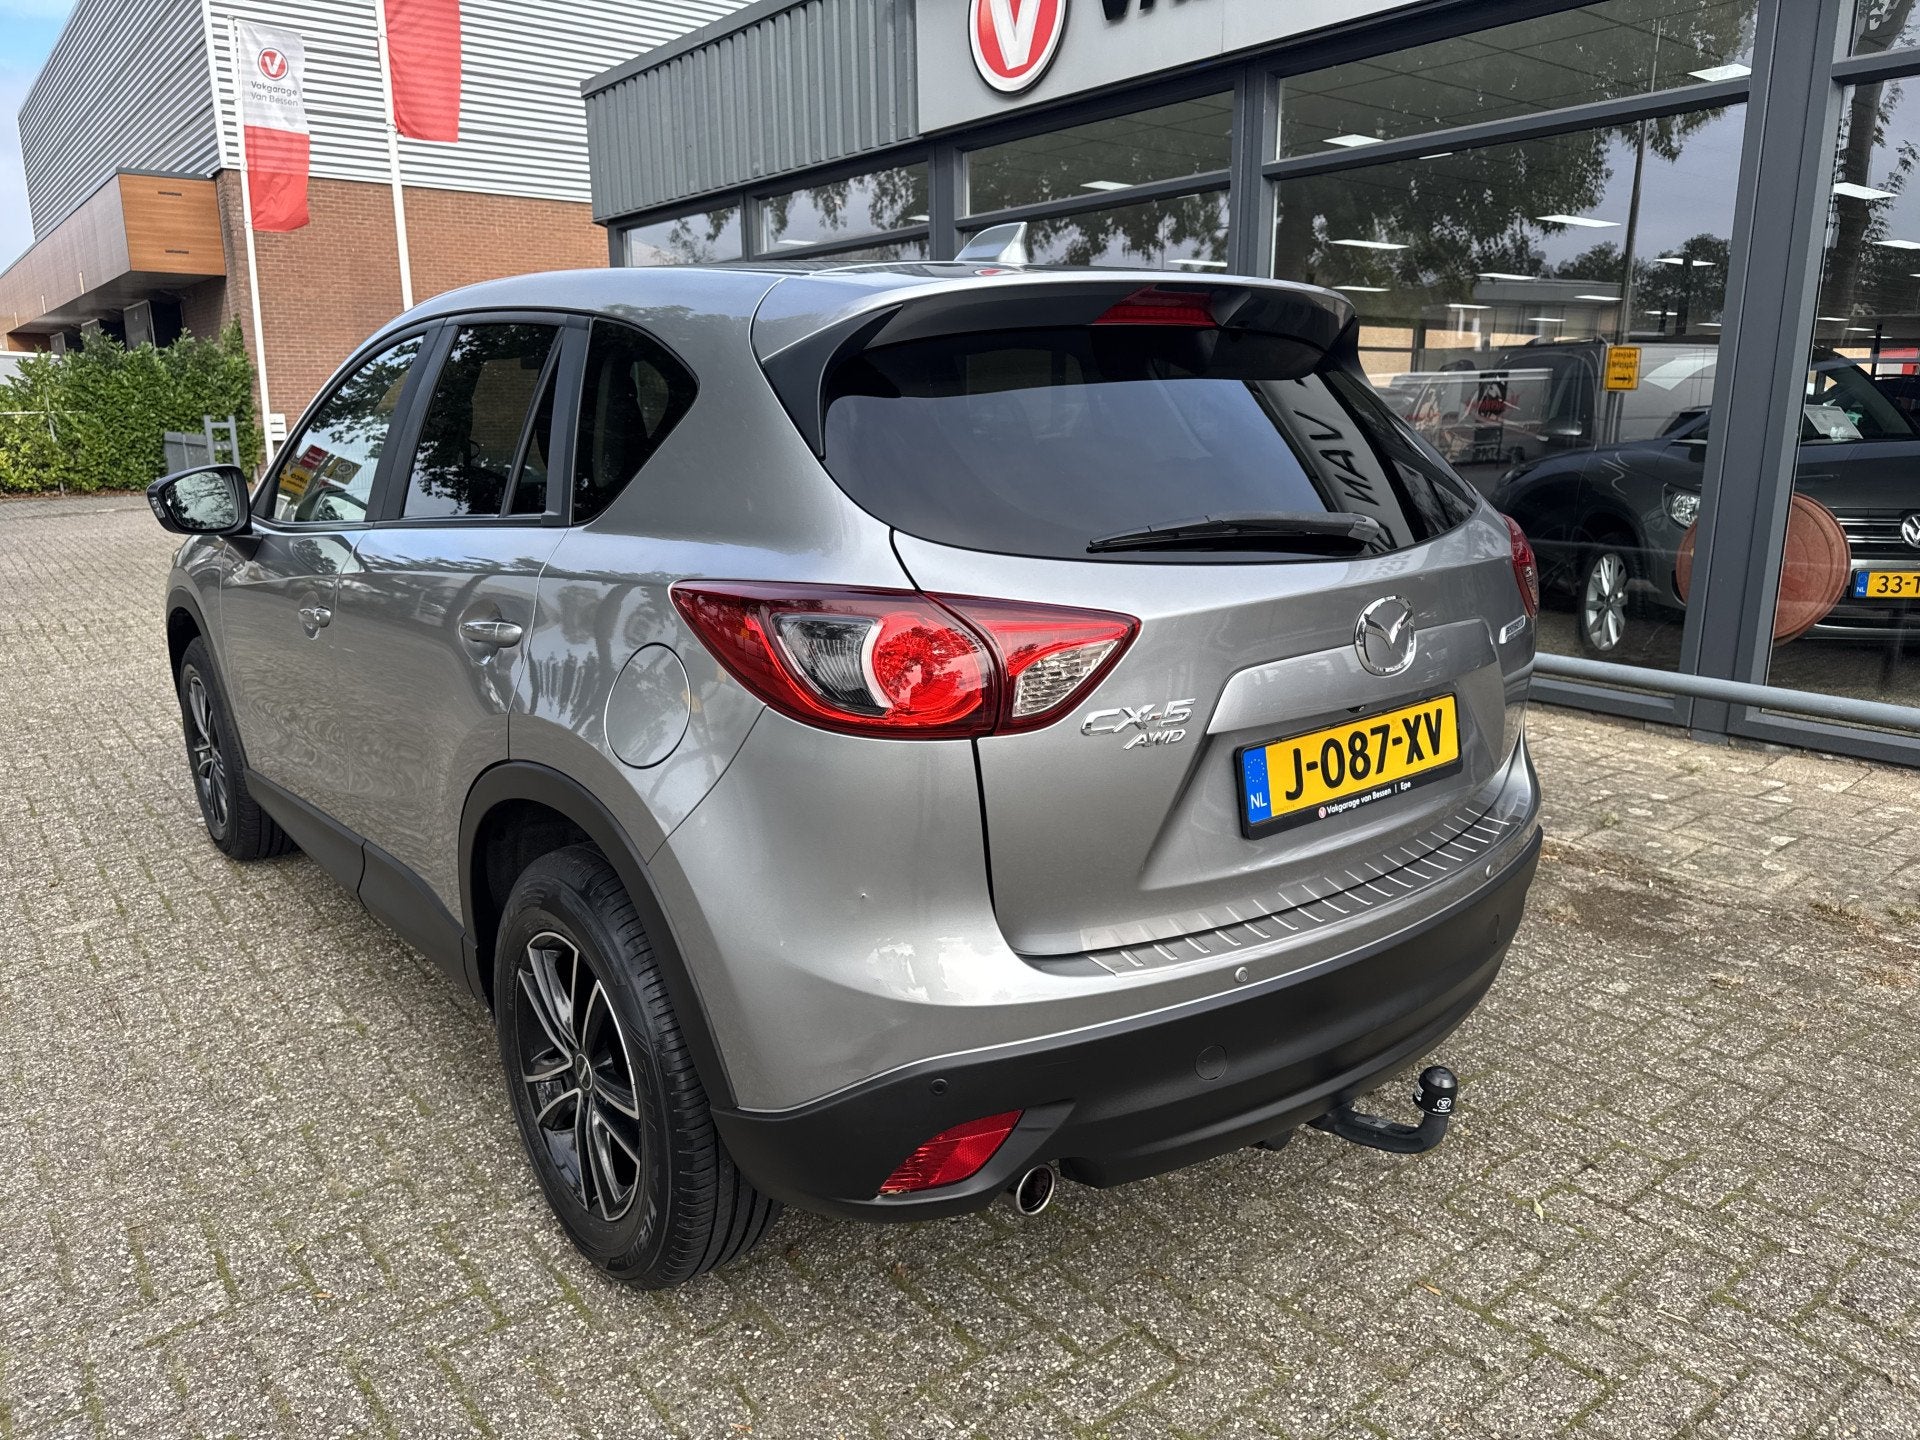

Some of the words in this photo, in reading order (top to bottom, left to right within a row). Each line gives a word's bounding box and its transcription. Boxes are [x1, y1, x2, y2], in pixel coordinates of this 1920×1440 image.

[250, 80, 298, 98] Vakgarage
[250, 92, 267, 102] Van
[269, 94, 299, 107] Bessen
[1080, 697, 1197, 736] CX-5
[1123, 728, 1187, 751] AWD
[1285, 708, 1443, 800] J-087-XV
[1250, 793, 1268, 810] NL
[1326, 797, 1360, 813] Vakgarage
[1360, 794, 1372, 804] van
[1372, 787, 1392, 800] Bessen
[1400, 781, 1412, 792] Epe
